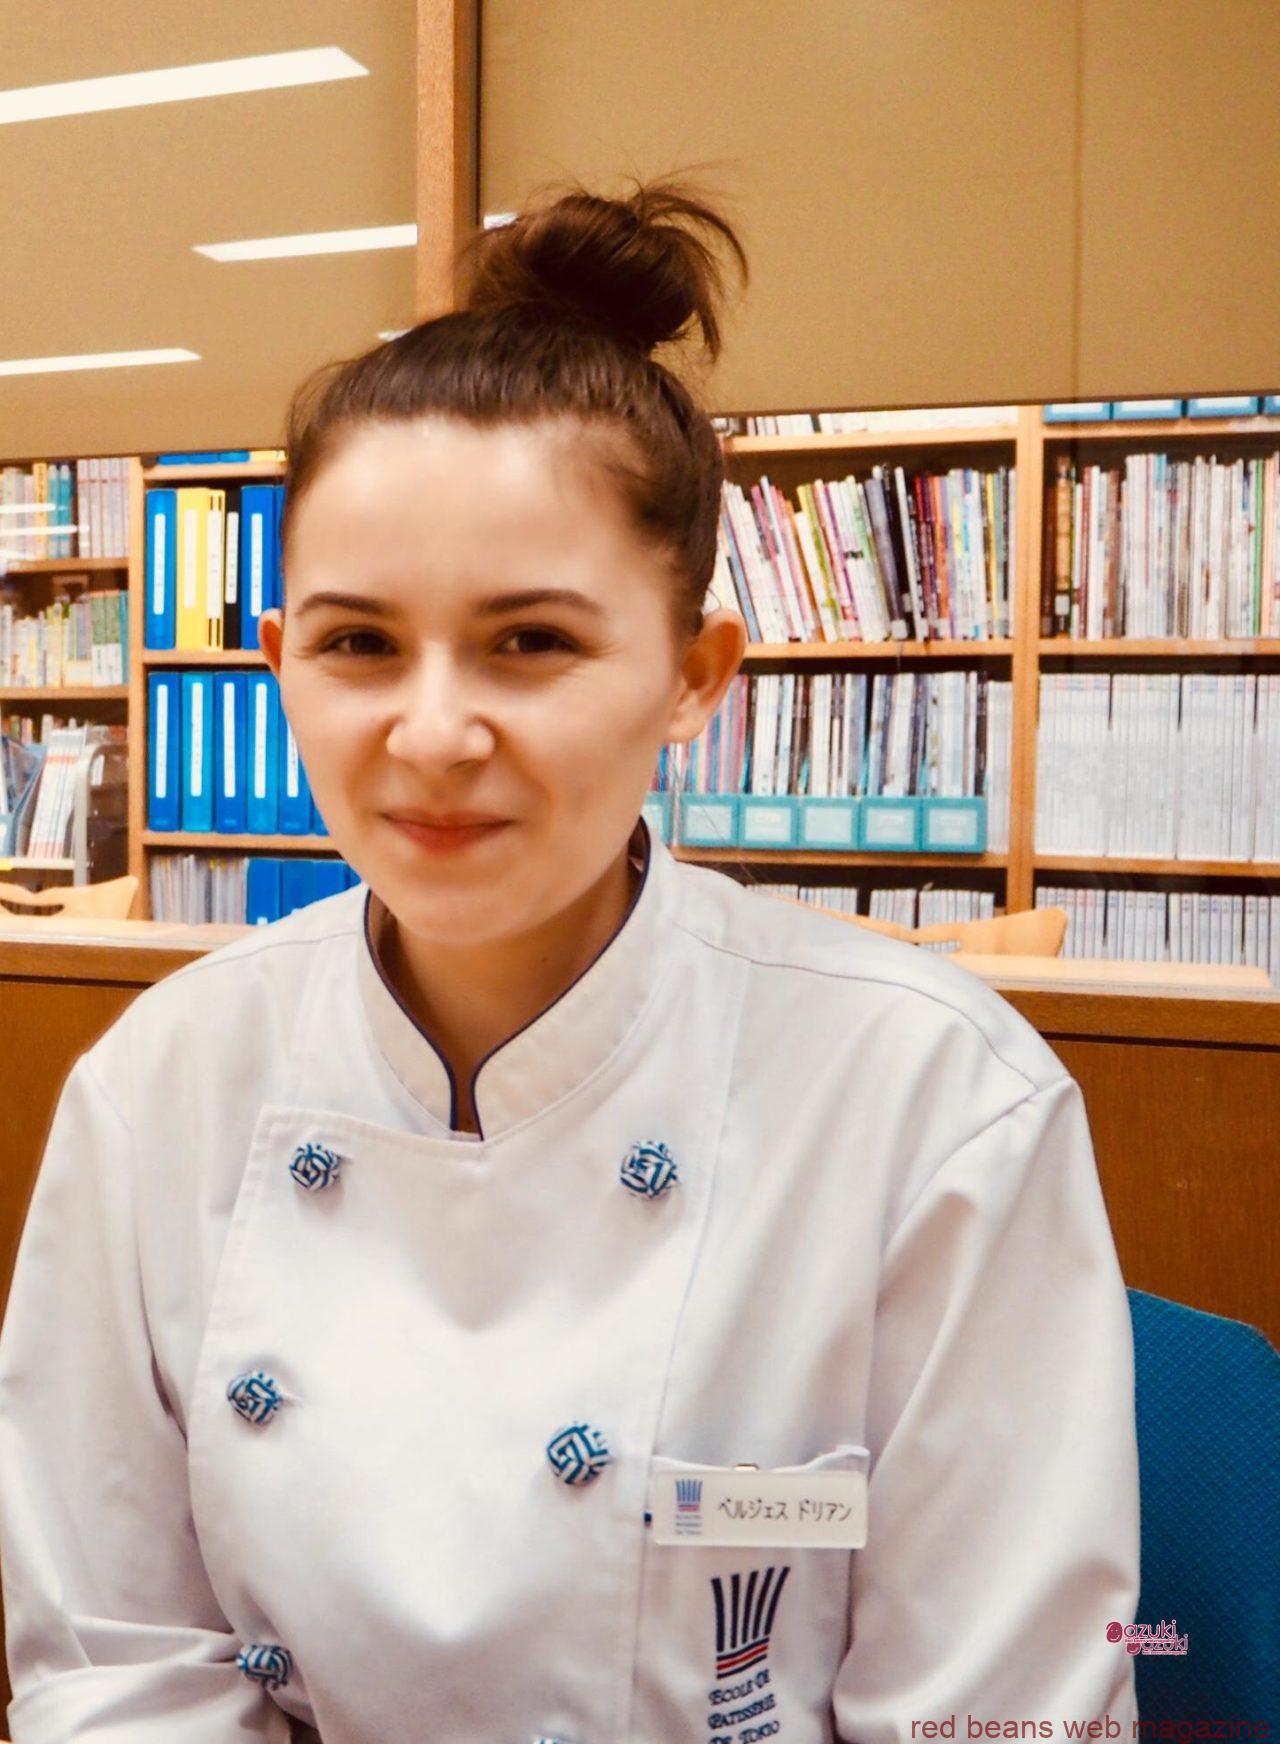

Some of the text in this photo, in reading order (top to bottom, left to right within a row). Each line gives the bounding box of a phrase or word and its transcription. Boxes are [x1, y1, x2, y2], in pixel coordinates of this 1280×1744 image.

[718, 1498, 852, 1521] ベルジェス ドリアン
